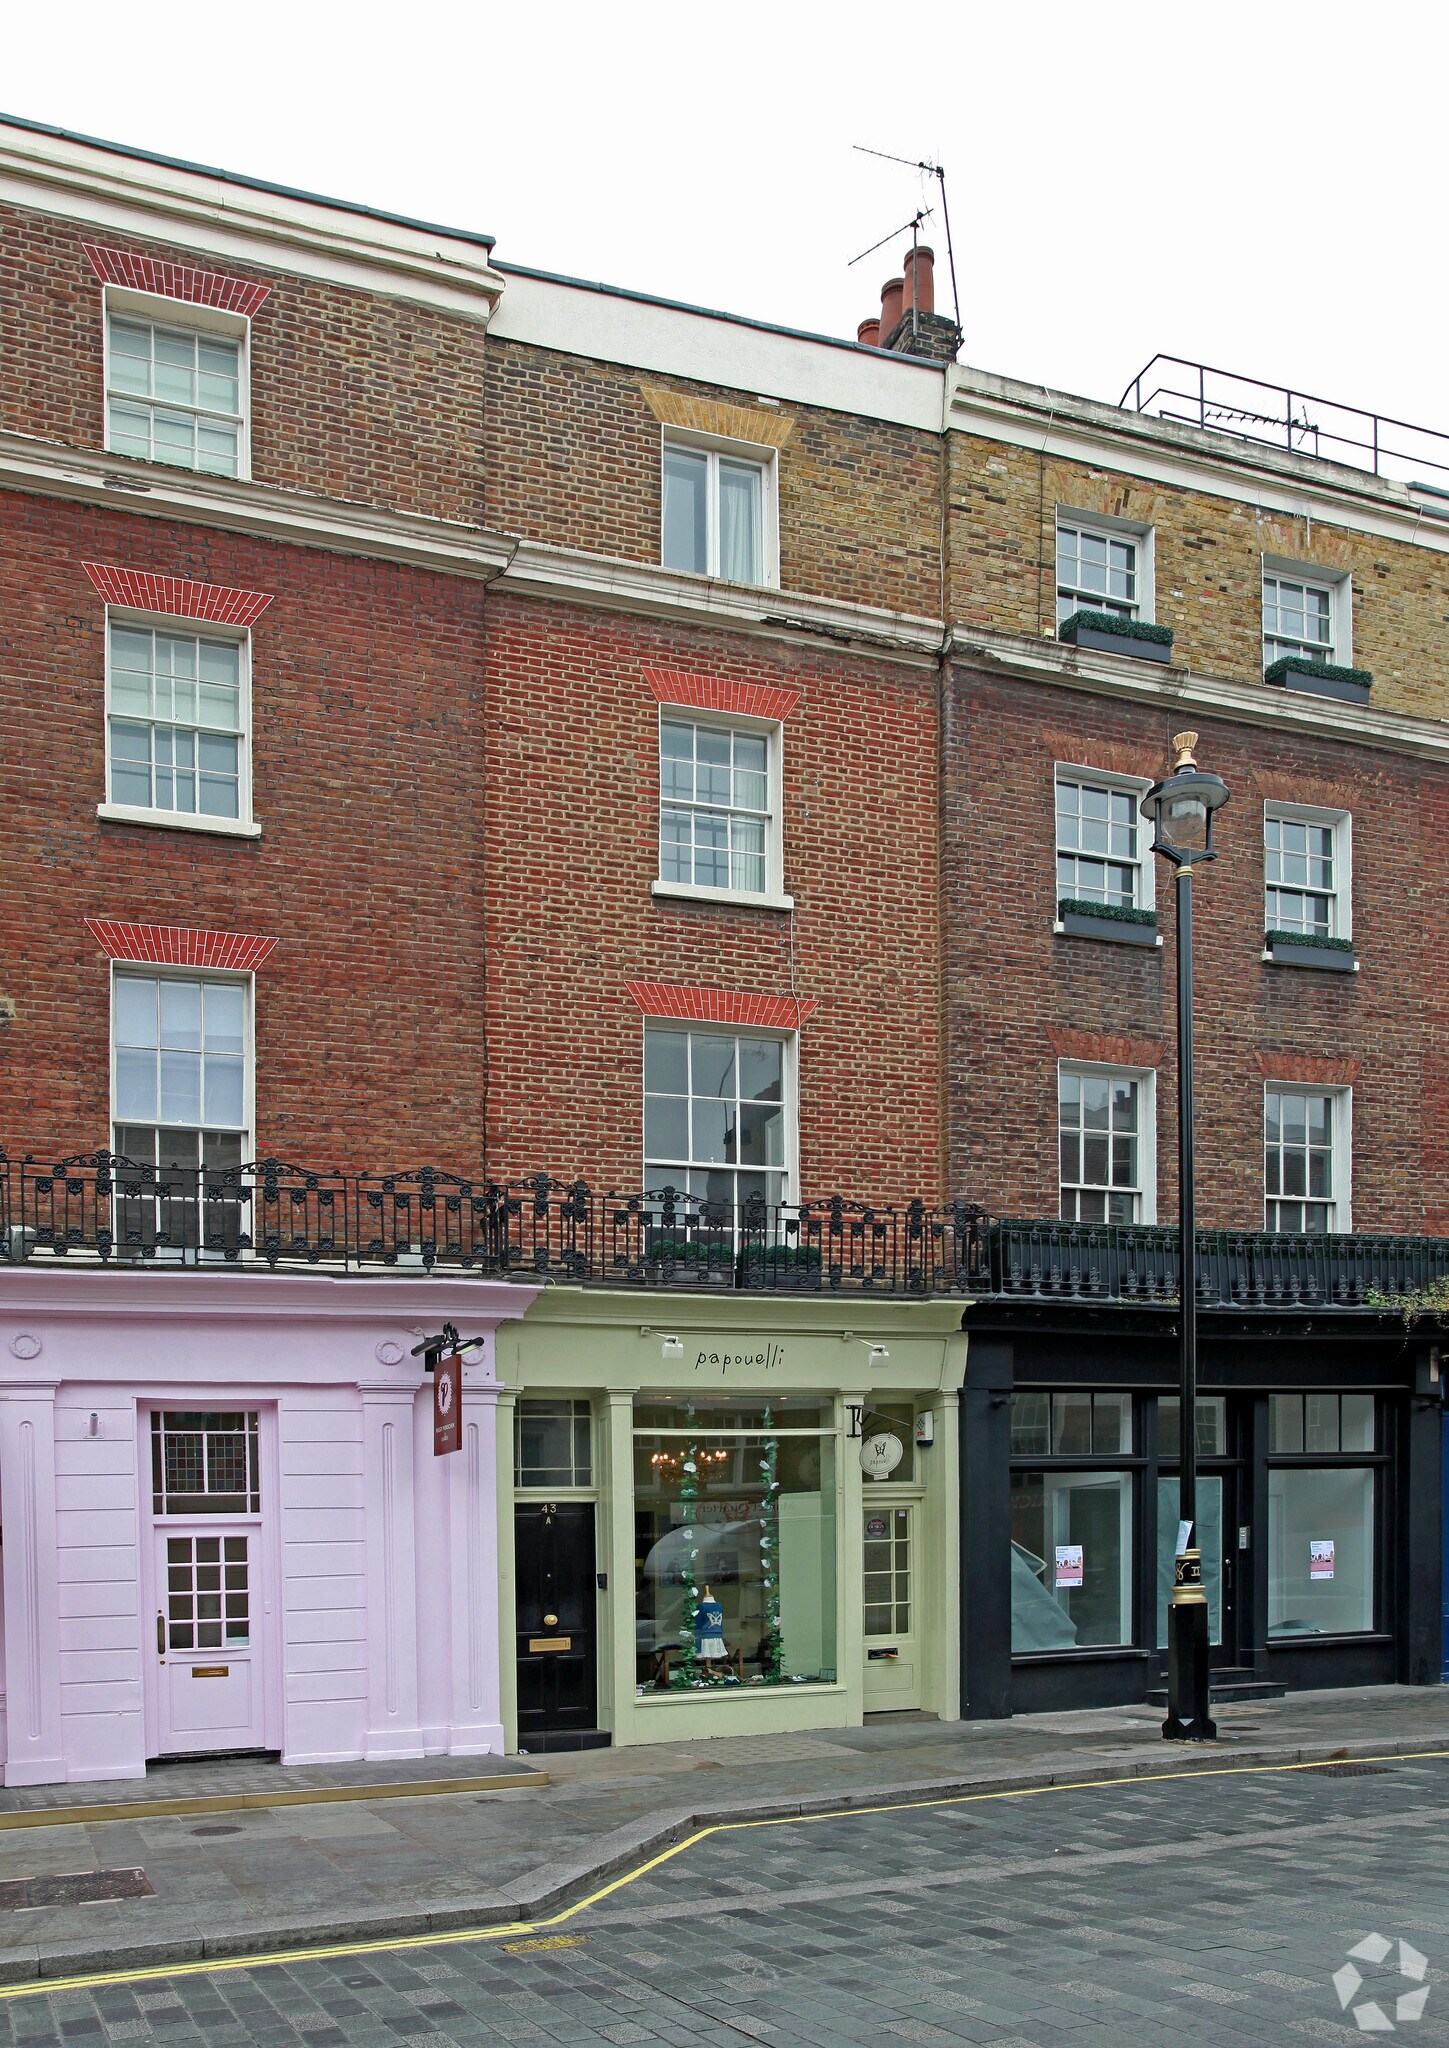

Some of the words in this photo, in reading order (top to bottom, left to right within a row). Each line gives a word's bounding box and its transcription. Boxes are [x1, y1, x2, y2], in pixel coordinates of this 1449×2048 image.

[694, 1342, 785, 1375] papouelli
[541, 1503, 557, 1514] 43
[545, 1516, 552, 1525] A
